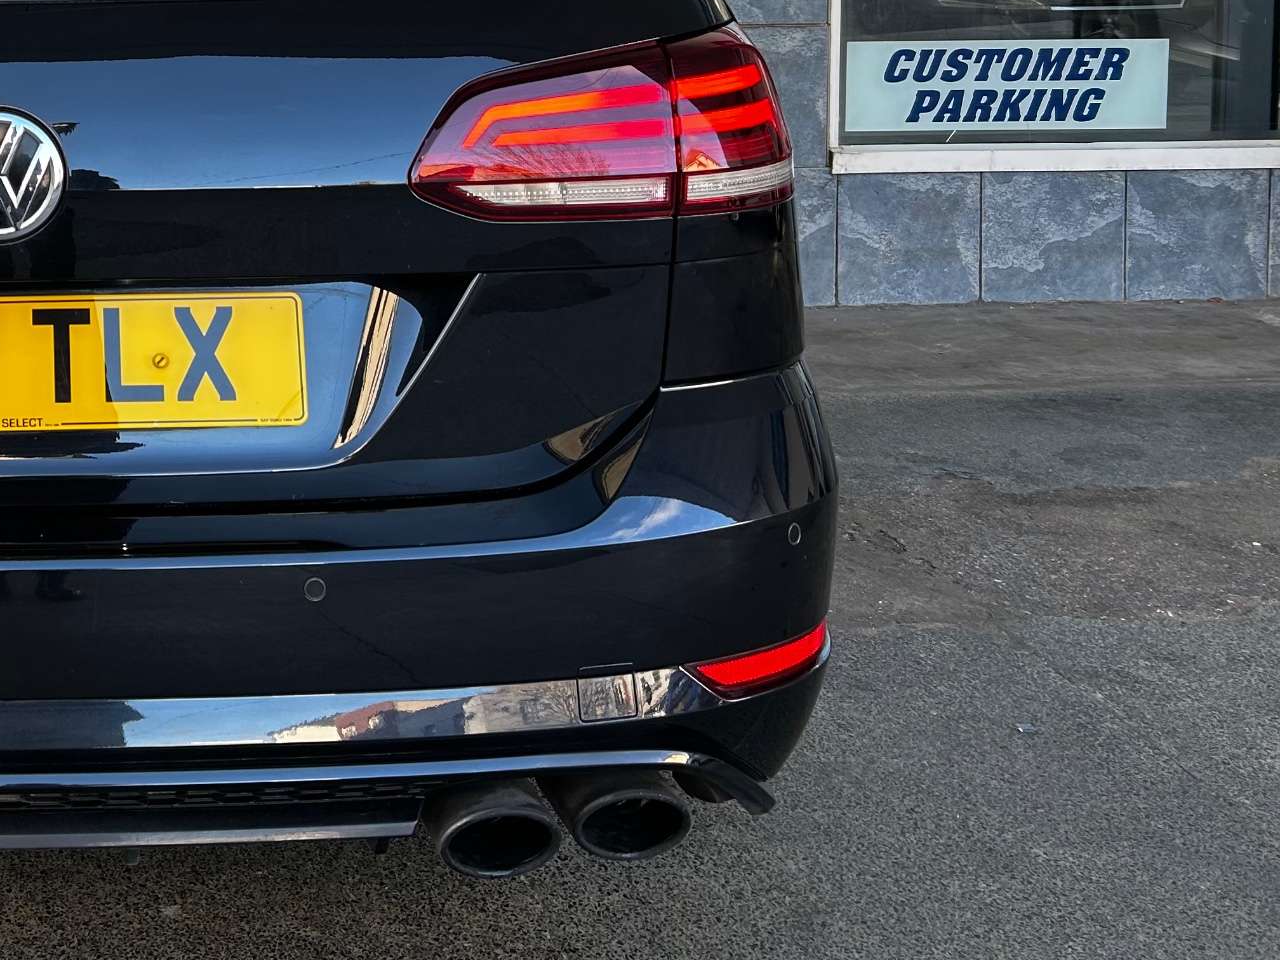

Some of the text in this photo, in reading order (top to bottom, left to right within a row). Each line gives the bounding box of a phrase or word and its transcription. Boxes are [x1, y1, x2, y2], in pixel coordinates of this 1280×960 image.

[883, 47, 1131, 84] CUSTOMER
[905, 87, 1106, 123] PARKING
[32, 305, 237, 405] TLX
[1, 417, 43, 428] SELECT
